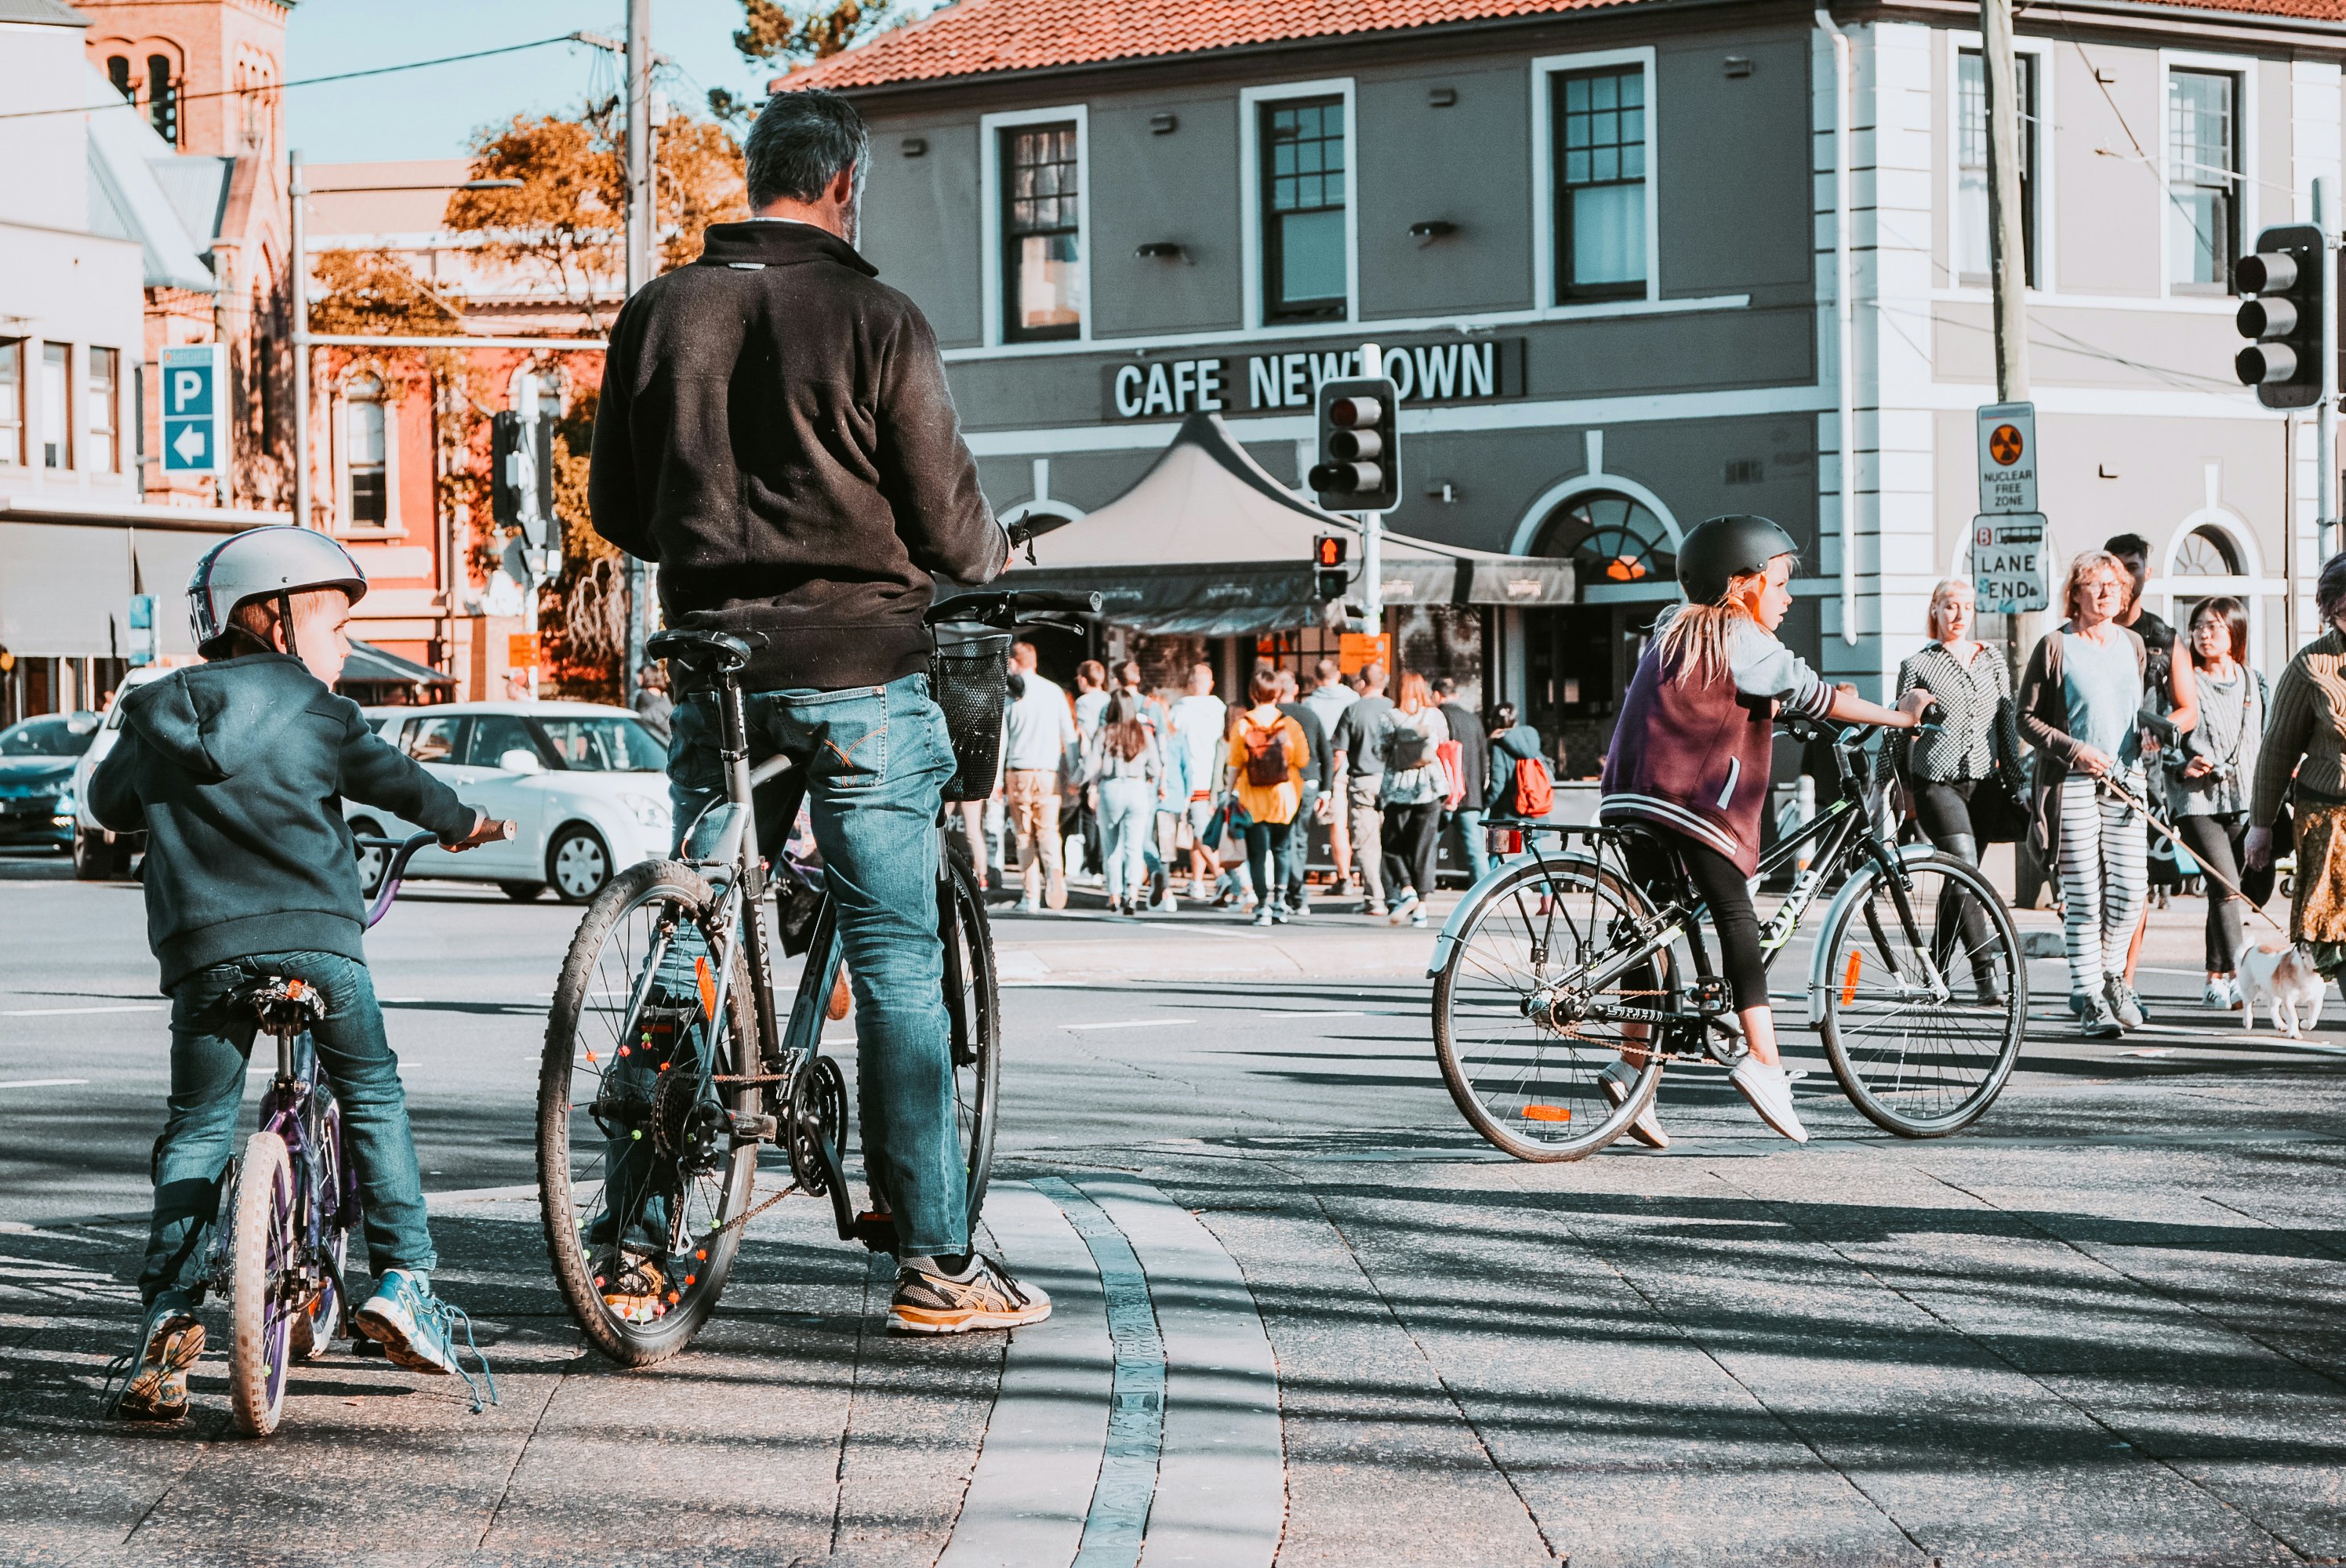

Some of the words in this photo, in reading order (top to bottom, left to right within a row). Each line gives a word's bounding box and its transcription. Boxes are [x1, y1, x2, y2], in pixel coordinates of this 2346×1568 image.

[174, 370, 202, 412] P
[1115, 359, 1222, 417] CAFE
[1984, 470, 2032, 482] NUCLEAR
[1995, 482, 2021, 494] FREE
[1995, 495, 2024, 506] ZONE
[1981, 554, 2036, 573] LANE
[1988, 581, 2029, 598] END
[754, 904, 772, 988] ROAM
